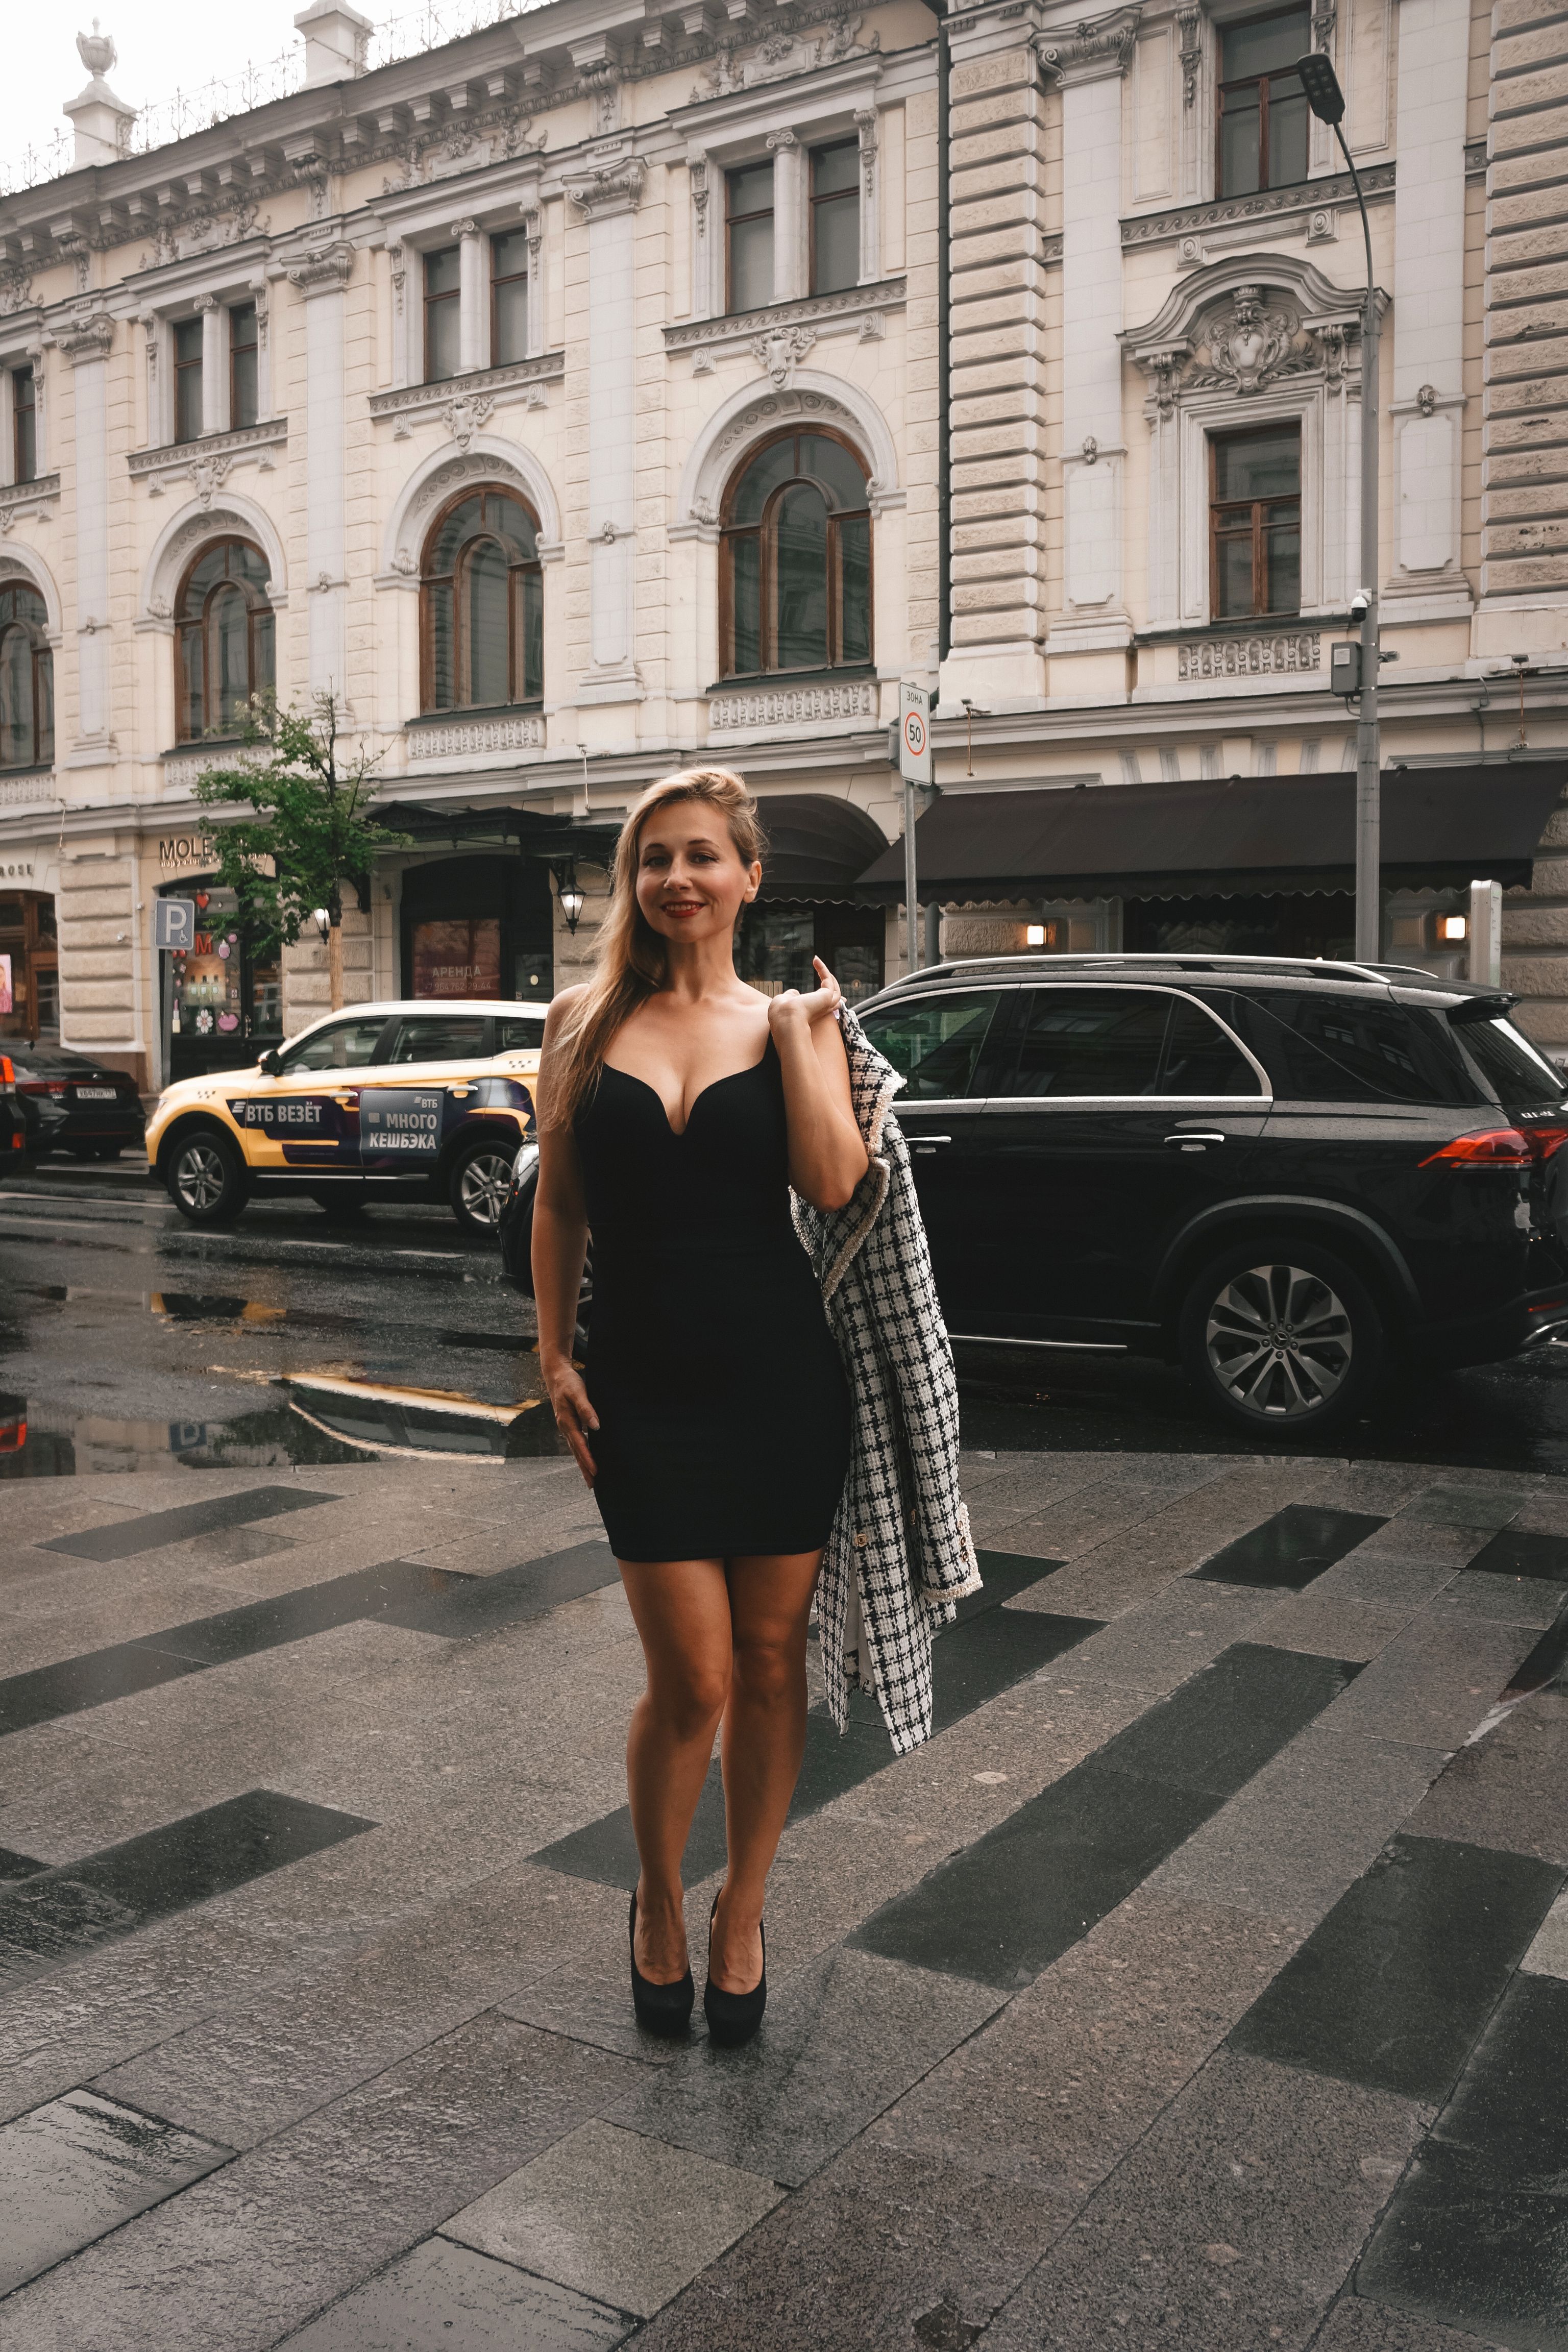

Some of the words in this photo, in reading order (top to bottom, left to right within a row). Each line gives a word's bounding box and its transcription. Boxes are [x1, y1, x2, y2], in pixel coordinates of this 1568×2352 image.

[907, 691, 923, 705] ЗОНА
[910, 724, 921, 743] 50
[160, 837, 215, 860] MOLE
[166, 904, 187, 943] P
[432, 965, 481, 979] АРЕНДА
[247, 1105, 274, 1122] ВТБ
[278, 1101, 322, 1122] ВЕЗЁТ
[422, 1098, 438, 1109] ВТБ
[386, 1113, 437, 1130] МНОГО
[370, 1133, 436, 1149] КЕШБЭКА
